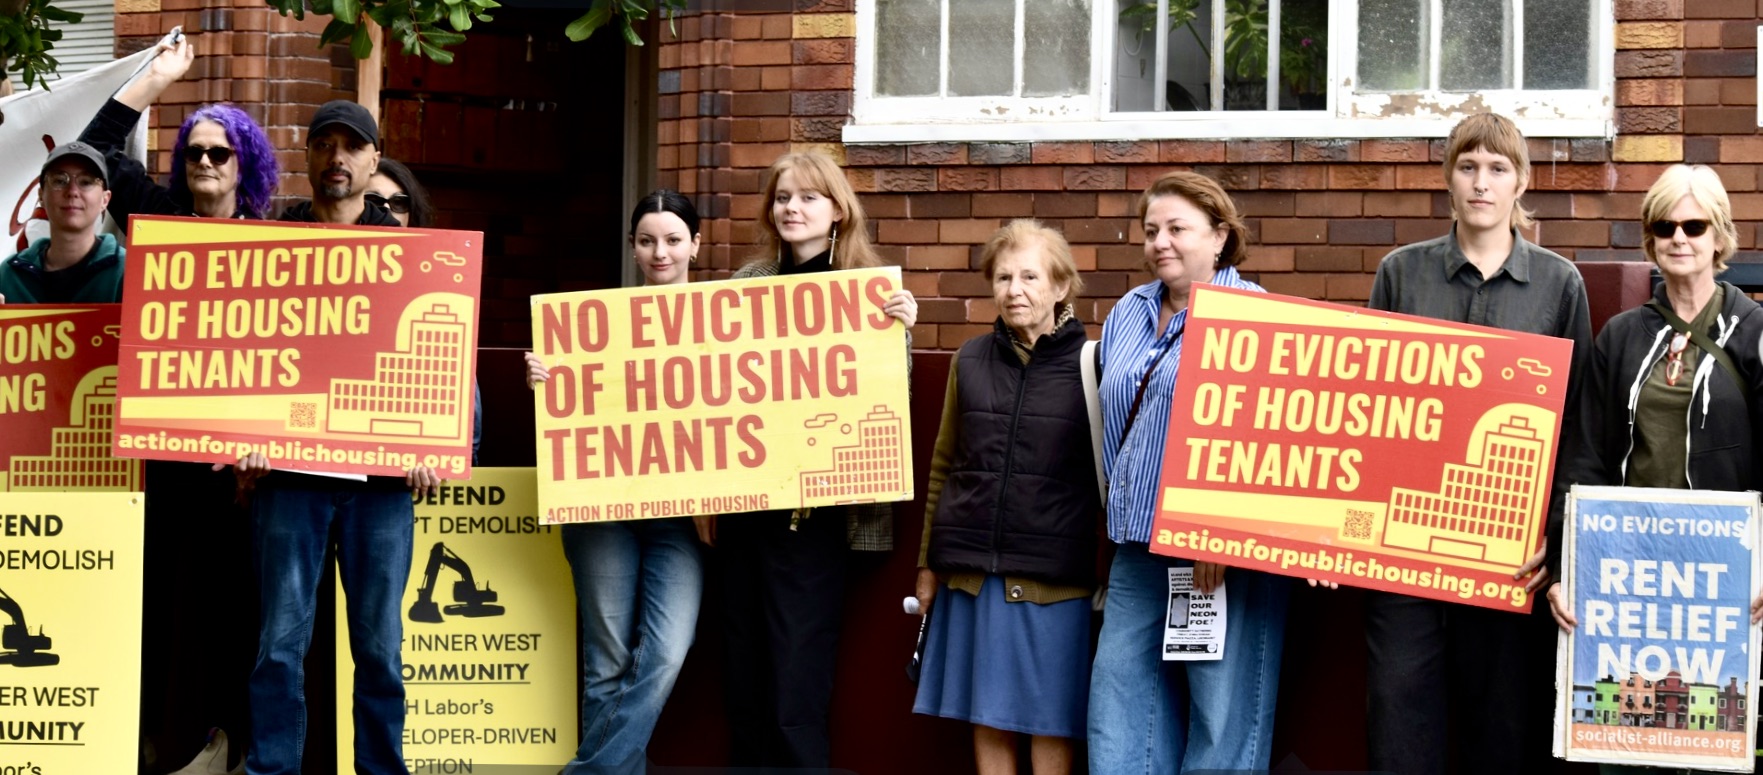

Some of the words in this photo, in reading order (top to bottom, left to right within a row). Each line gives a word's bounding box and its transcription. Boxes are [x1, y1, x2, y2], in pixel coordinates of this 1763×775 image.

[143, 250, 195, 290] NO
[206, 244, 403, 289] EVICTIONS
[140, 301, 186, 341] OF
[200, 295, 370, 338] HOUSING
[542, 299, 609, 355] NO
[630, 276, 896, 349] EVICTIONS
[0, 320, 76, 364] ONS
[1200, 327, 1259, 373] NO
[1268, 332, 1485, 388] EVICTIONS
[137, 348, 301, 390] TENANTS
[544, 362, 604, 418] OF
[625, 344, 858, 412] HOUSING
[1192, 383, 1246, 427] OF
[1253, 388, 1444, 442] HOUSING
[118, 431, 466, 474] actionforpublichousing.org
[544, 414, 767, 481] TENANTS
[1186, 437, 1362, 492] TENANTS
[0, 514, 63, 537] END
[546, 505, 600, 523] ACTION
[606, 503, 635, 520] FOR
[640, 499, 696, 518] PUBLIC
[701, 494, 769, 514] HOUSING
[1583, 514, 1617, 533] NO
[1622, 516, 1746, 538] EVICTIONS
[0, 550, 114, 570] EMOLISH
[1156, 527, 1528, 607] actionforpublichousing.org
[1600, 558, 1728, 600] RENT
[1585, 600, 1741, 642] RELIEF
[411, 634, 478, 651] INNER
[482, 634, 541, 651] WEST
[1598, 643, 1725, 684] NOW
[33, 687, 100, 707] WEST
[425, 699, 494, 715] Labor's
[0, 721, 85, 741] UNITY
[1576, 729, 1742, 752] socialist-alliance.org
[0, 762, 42, 775] or's
